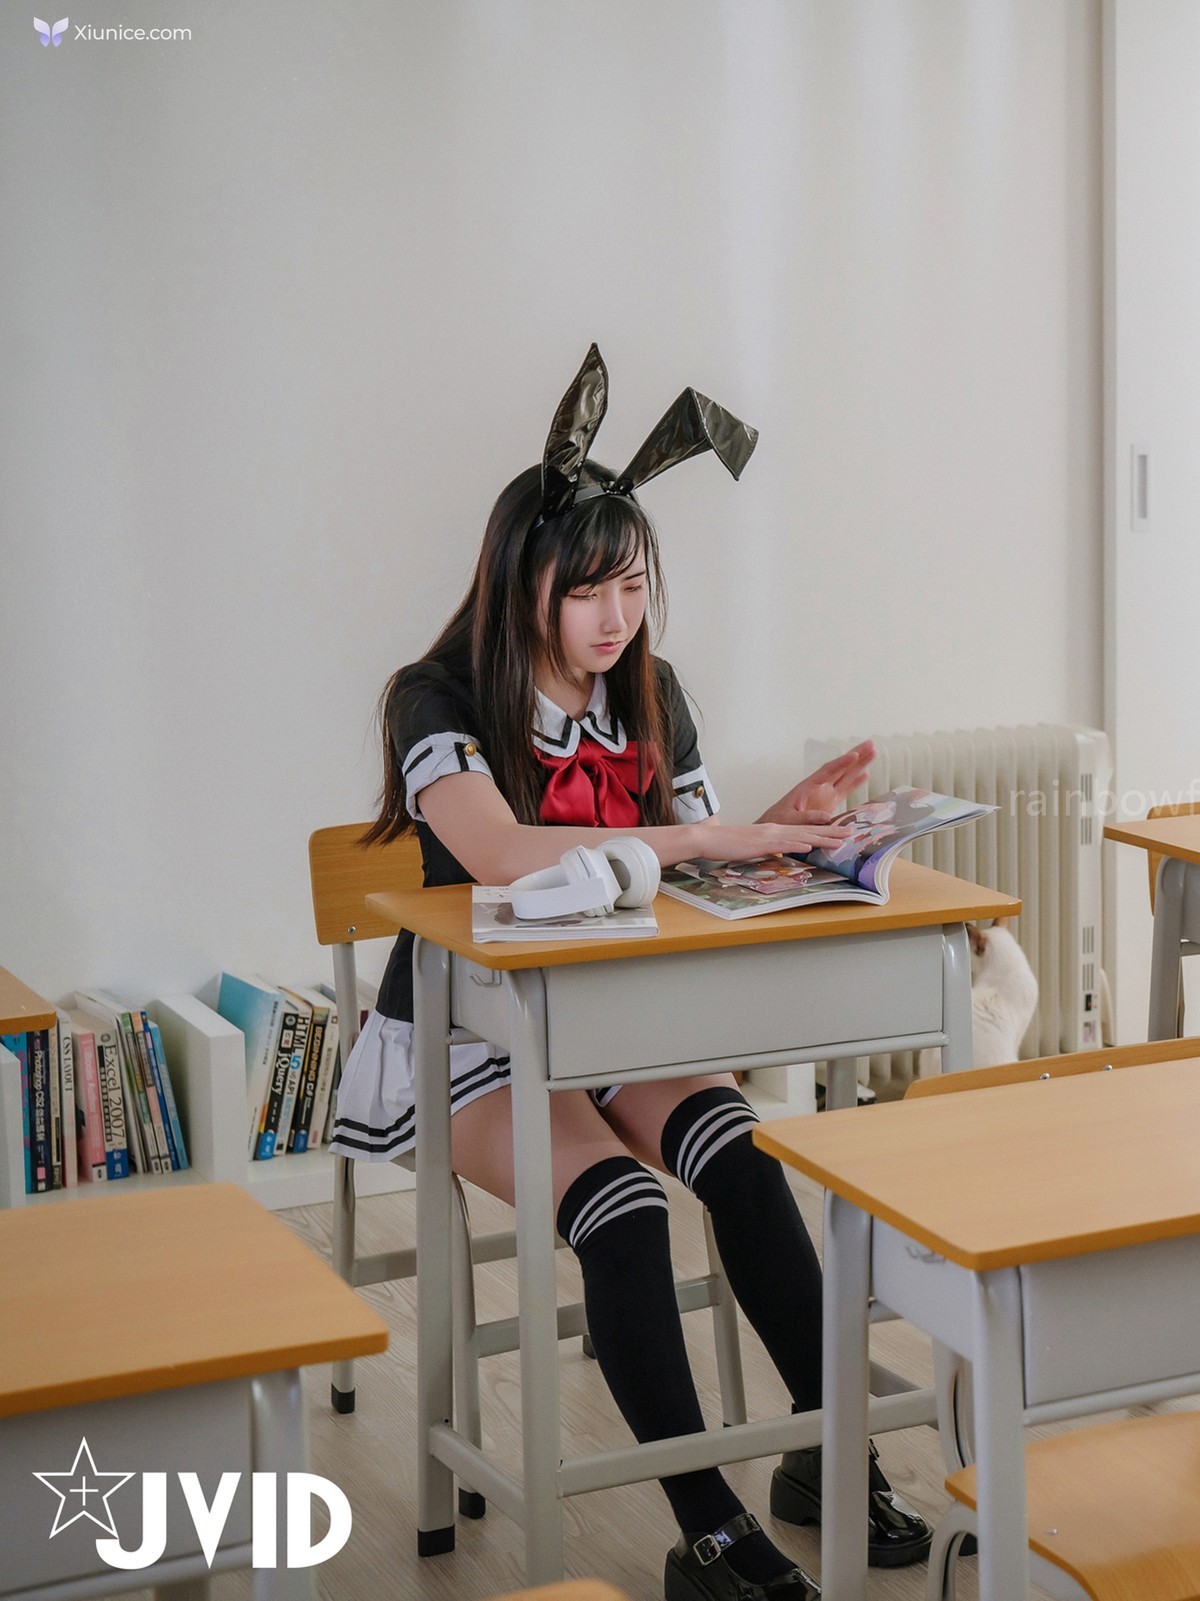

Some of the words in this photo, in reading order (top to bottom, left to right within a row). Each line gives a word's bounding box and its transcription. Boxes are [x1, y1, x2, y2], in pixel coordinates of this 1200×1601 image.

[62, 1036, 71, 1057] CSS
[293, 1015, 310, 1053] HTML
[33, 1050, 43, 1091] Photoshop
[64, 1058, 73, 1092] LAYOUT
[104, 1045, 120, 1092] Excel
[271, 1050, 291, 1095] jQuery
[290, 1055, 302, 1071] 5
[35, 1090, 45, 1108] CS2
[109, 1096, 126, 1139] 2007
